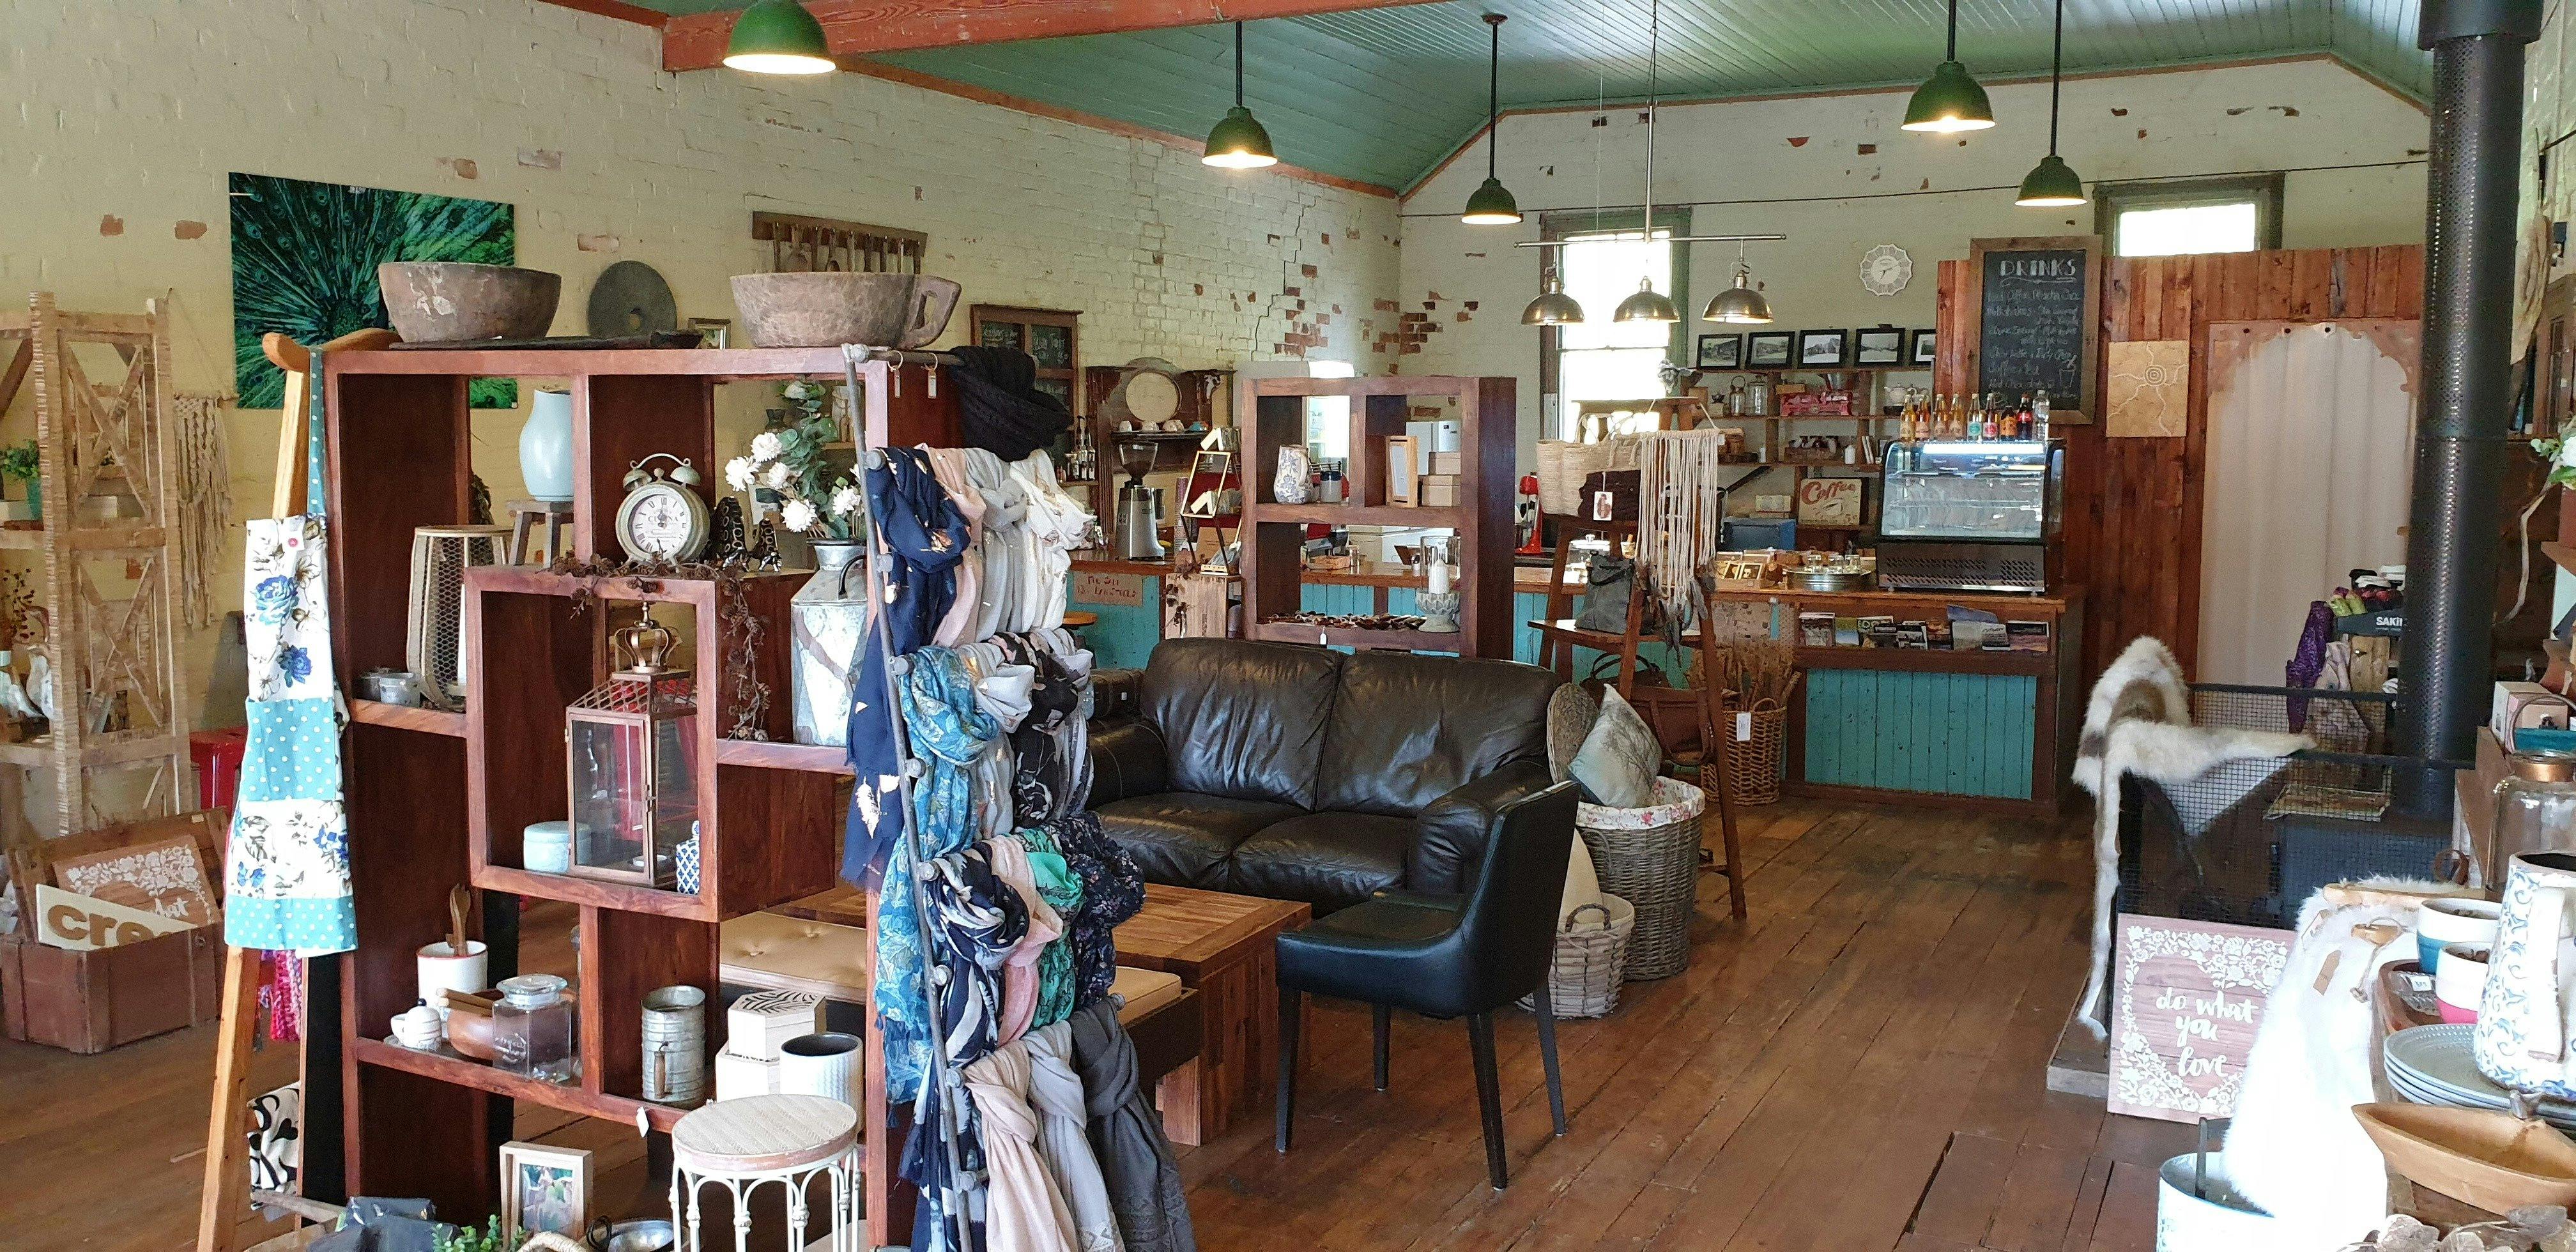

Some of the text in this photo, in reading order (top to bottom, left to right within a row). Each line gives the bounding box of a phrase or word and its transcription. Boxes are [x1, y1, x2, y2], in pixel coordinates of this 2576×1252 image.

[2000, 259, 2076, 276] DRINKS
[1802, 481, 1856, 505] Coffee
[2156, 987, 2259, 1023] do what
[2175, 1015, 2218, 1048] you
[2178, 1046, 2228, 1077] love
